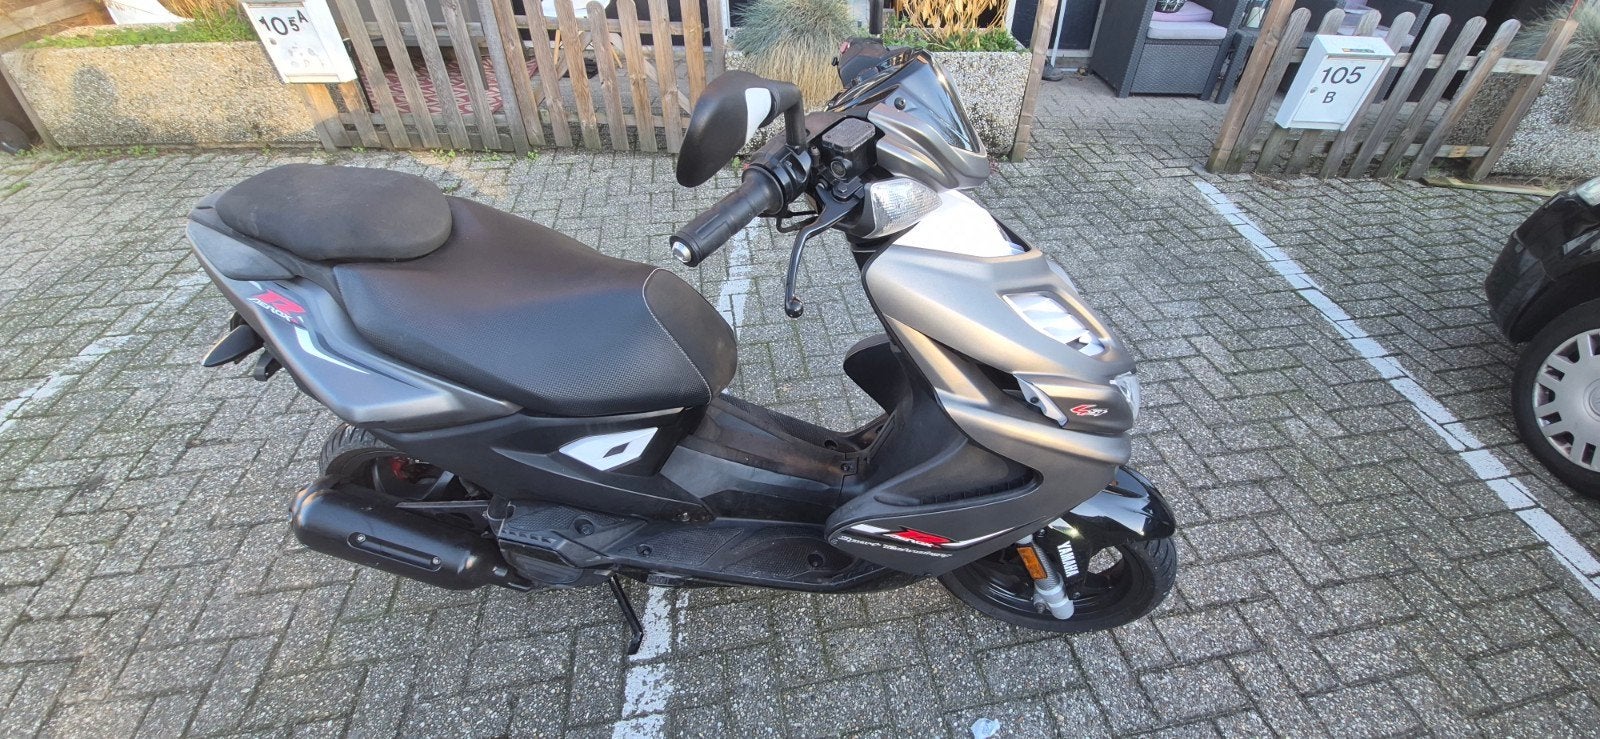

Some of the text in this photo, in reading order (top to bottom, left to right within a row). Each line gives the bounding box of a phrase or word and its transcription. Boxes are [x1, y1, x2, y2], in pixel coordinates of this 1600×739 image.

[1321, 66, 1366, 84] 105
[1322, 91, 1337, 104] B
[1057, 540, 1080, 578] YAMAHA
